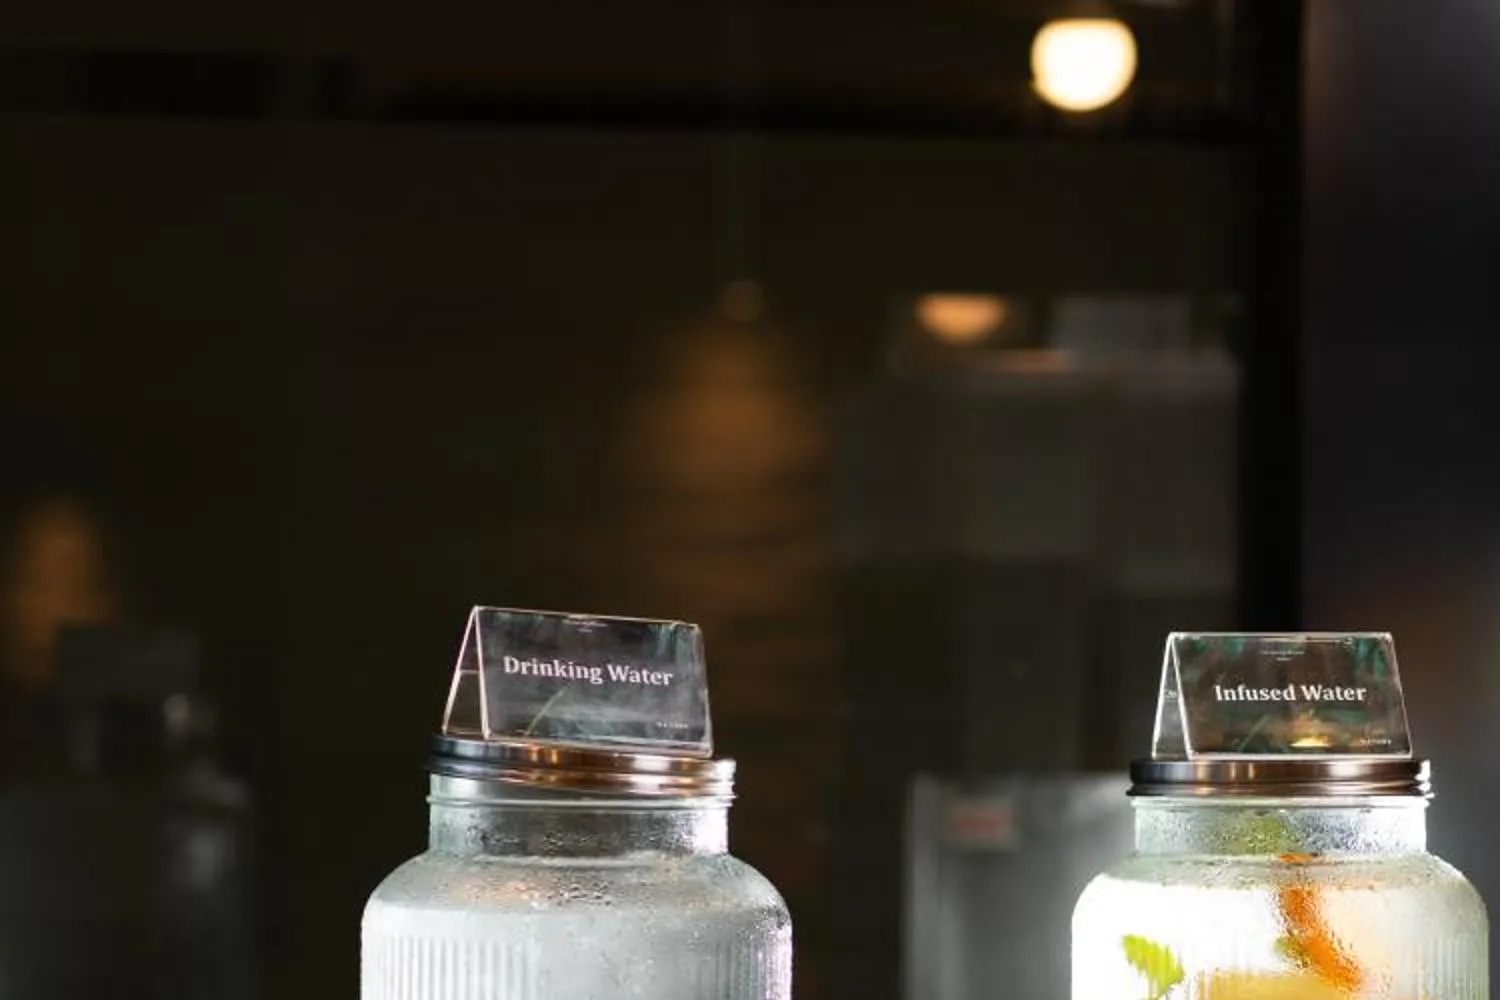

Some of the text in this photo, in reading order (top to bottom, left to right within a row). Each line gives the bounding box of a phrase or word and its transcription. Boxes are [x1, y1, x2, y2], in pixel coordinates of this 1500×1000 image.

[503, 655, 675, 686] Drinking Water
[1214, 683, 1367, 702] Infused Water
